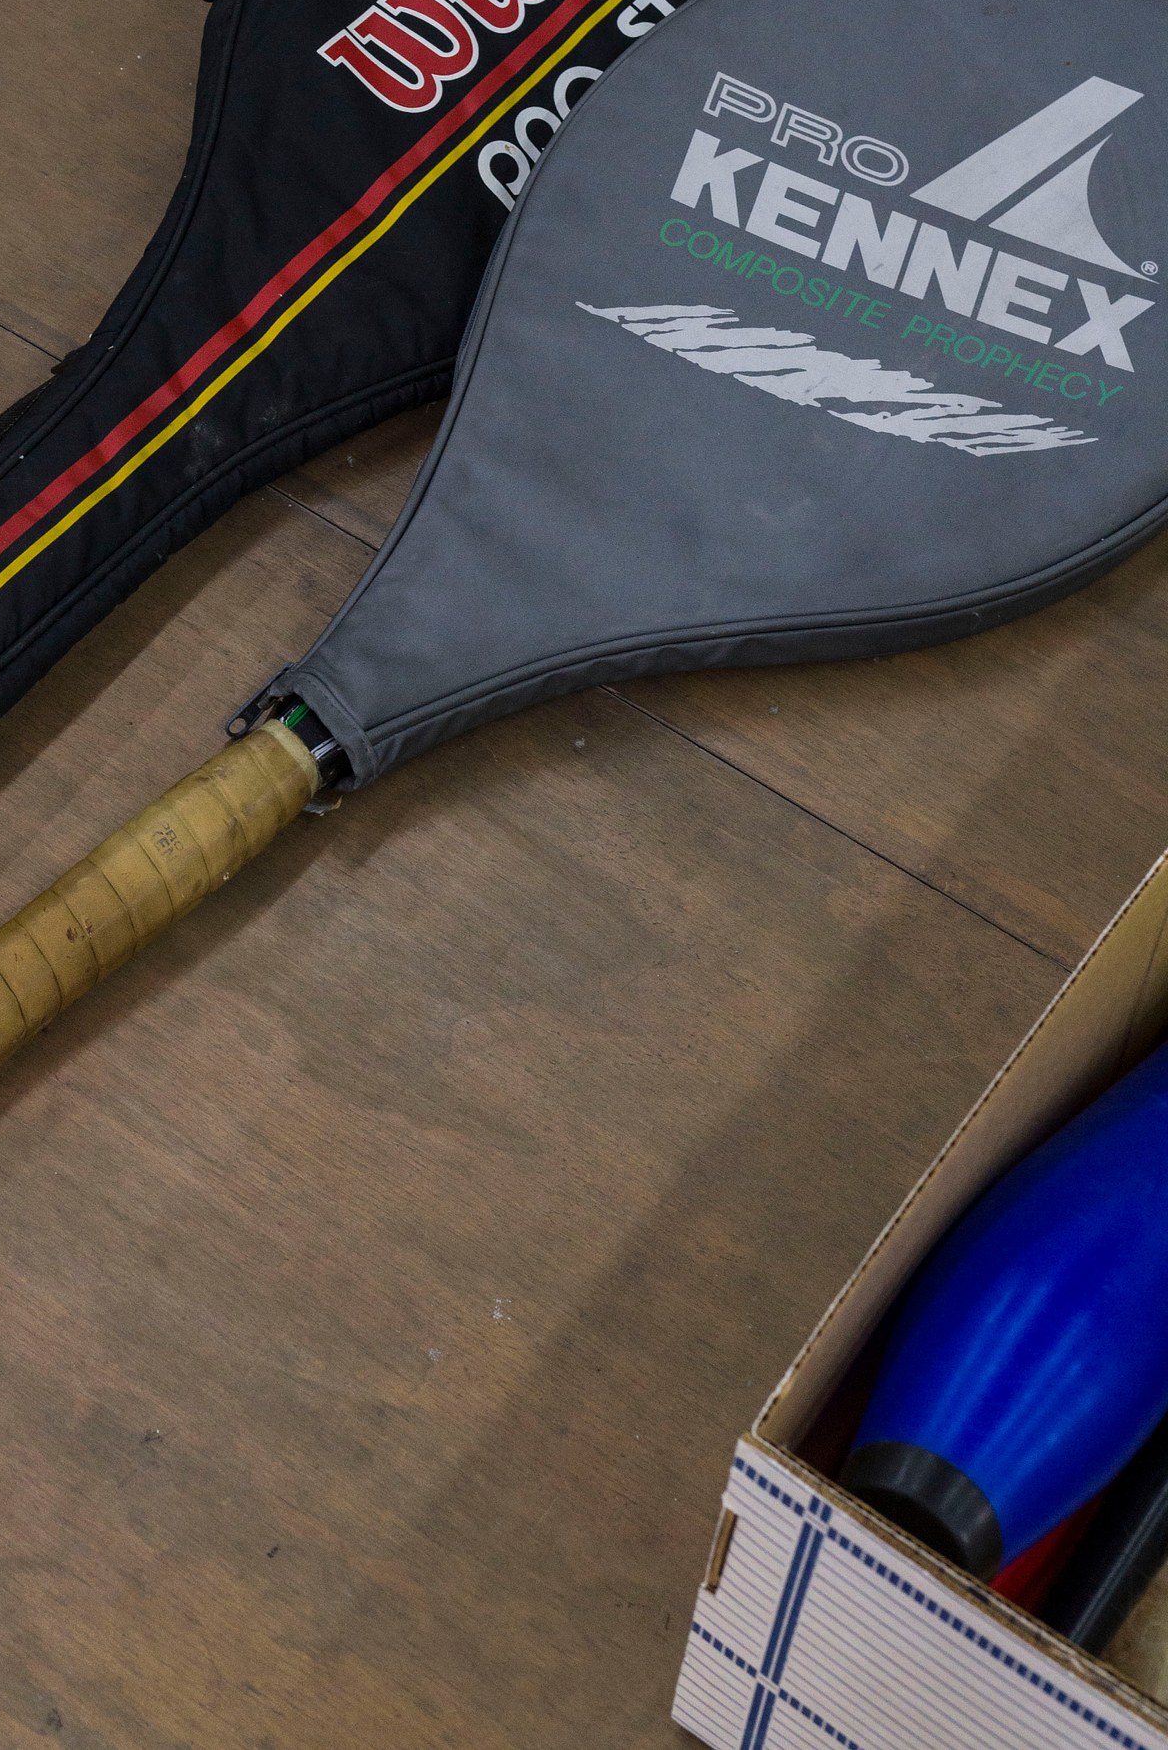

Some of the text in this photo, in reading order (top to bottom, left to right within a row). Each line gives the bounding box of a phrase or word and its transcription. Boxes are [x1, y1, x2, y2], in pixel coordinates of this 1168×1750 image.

[701, 70, 910, 187] PRO
[658, 216, 1125, 410] COMPOSITE PROPHECY
[669, 127, 1156, 374] KENNEX
